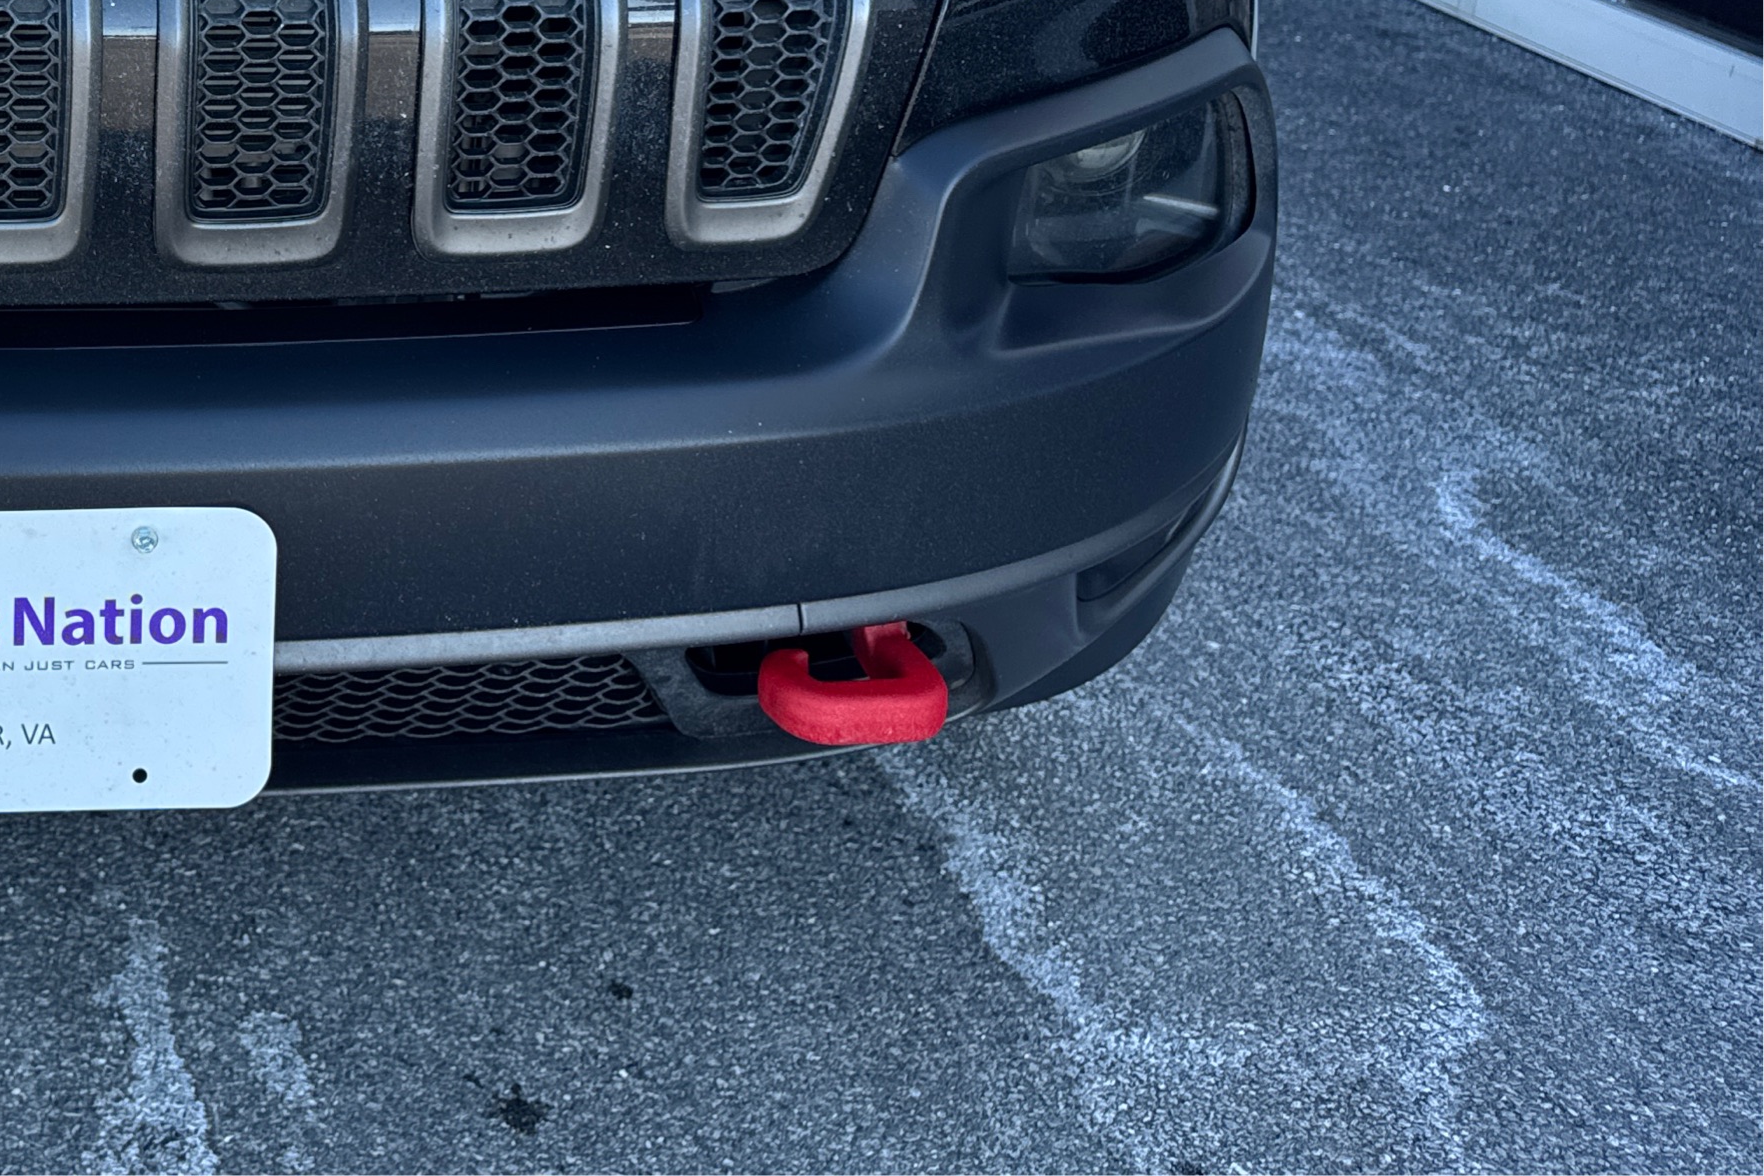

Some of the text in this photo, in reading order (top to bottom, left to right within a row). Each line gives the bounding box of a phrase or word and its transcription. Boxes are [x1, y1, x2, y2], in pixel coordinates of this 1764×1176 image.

[13, 593, 229, 646] Nation
[23, 660, 76, 672] JUST
[84, 659, 136, 671] CARS
[21, 723, 57, 746] VA
